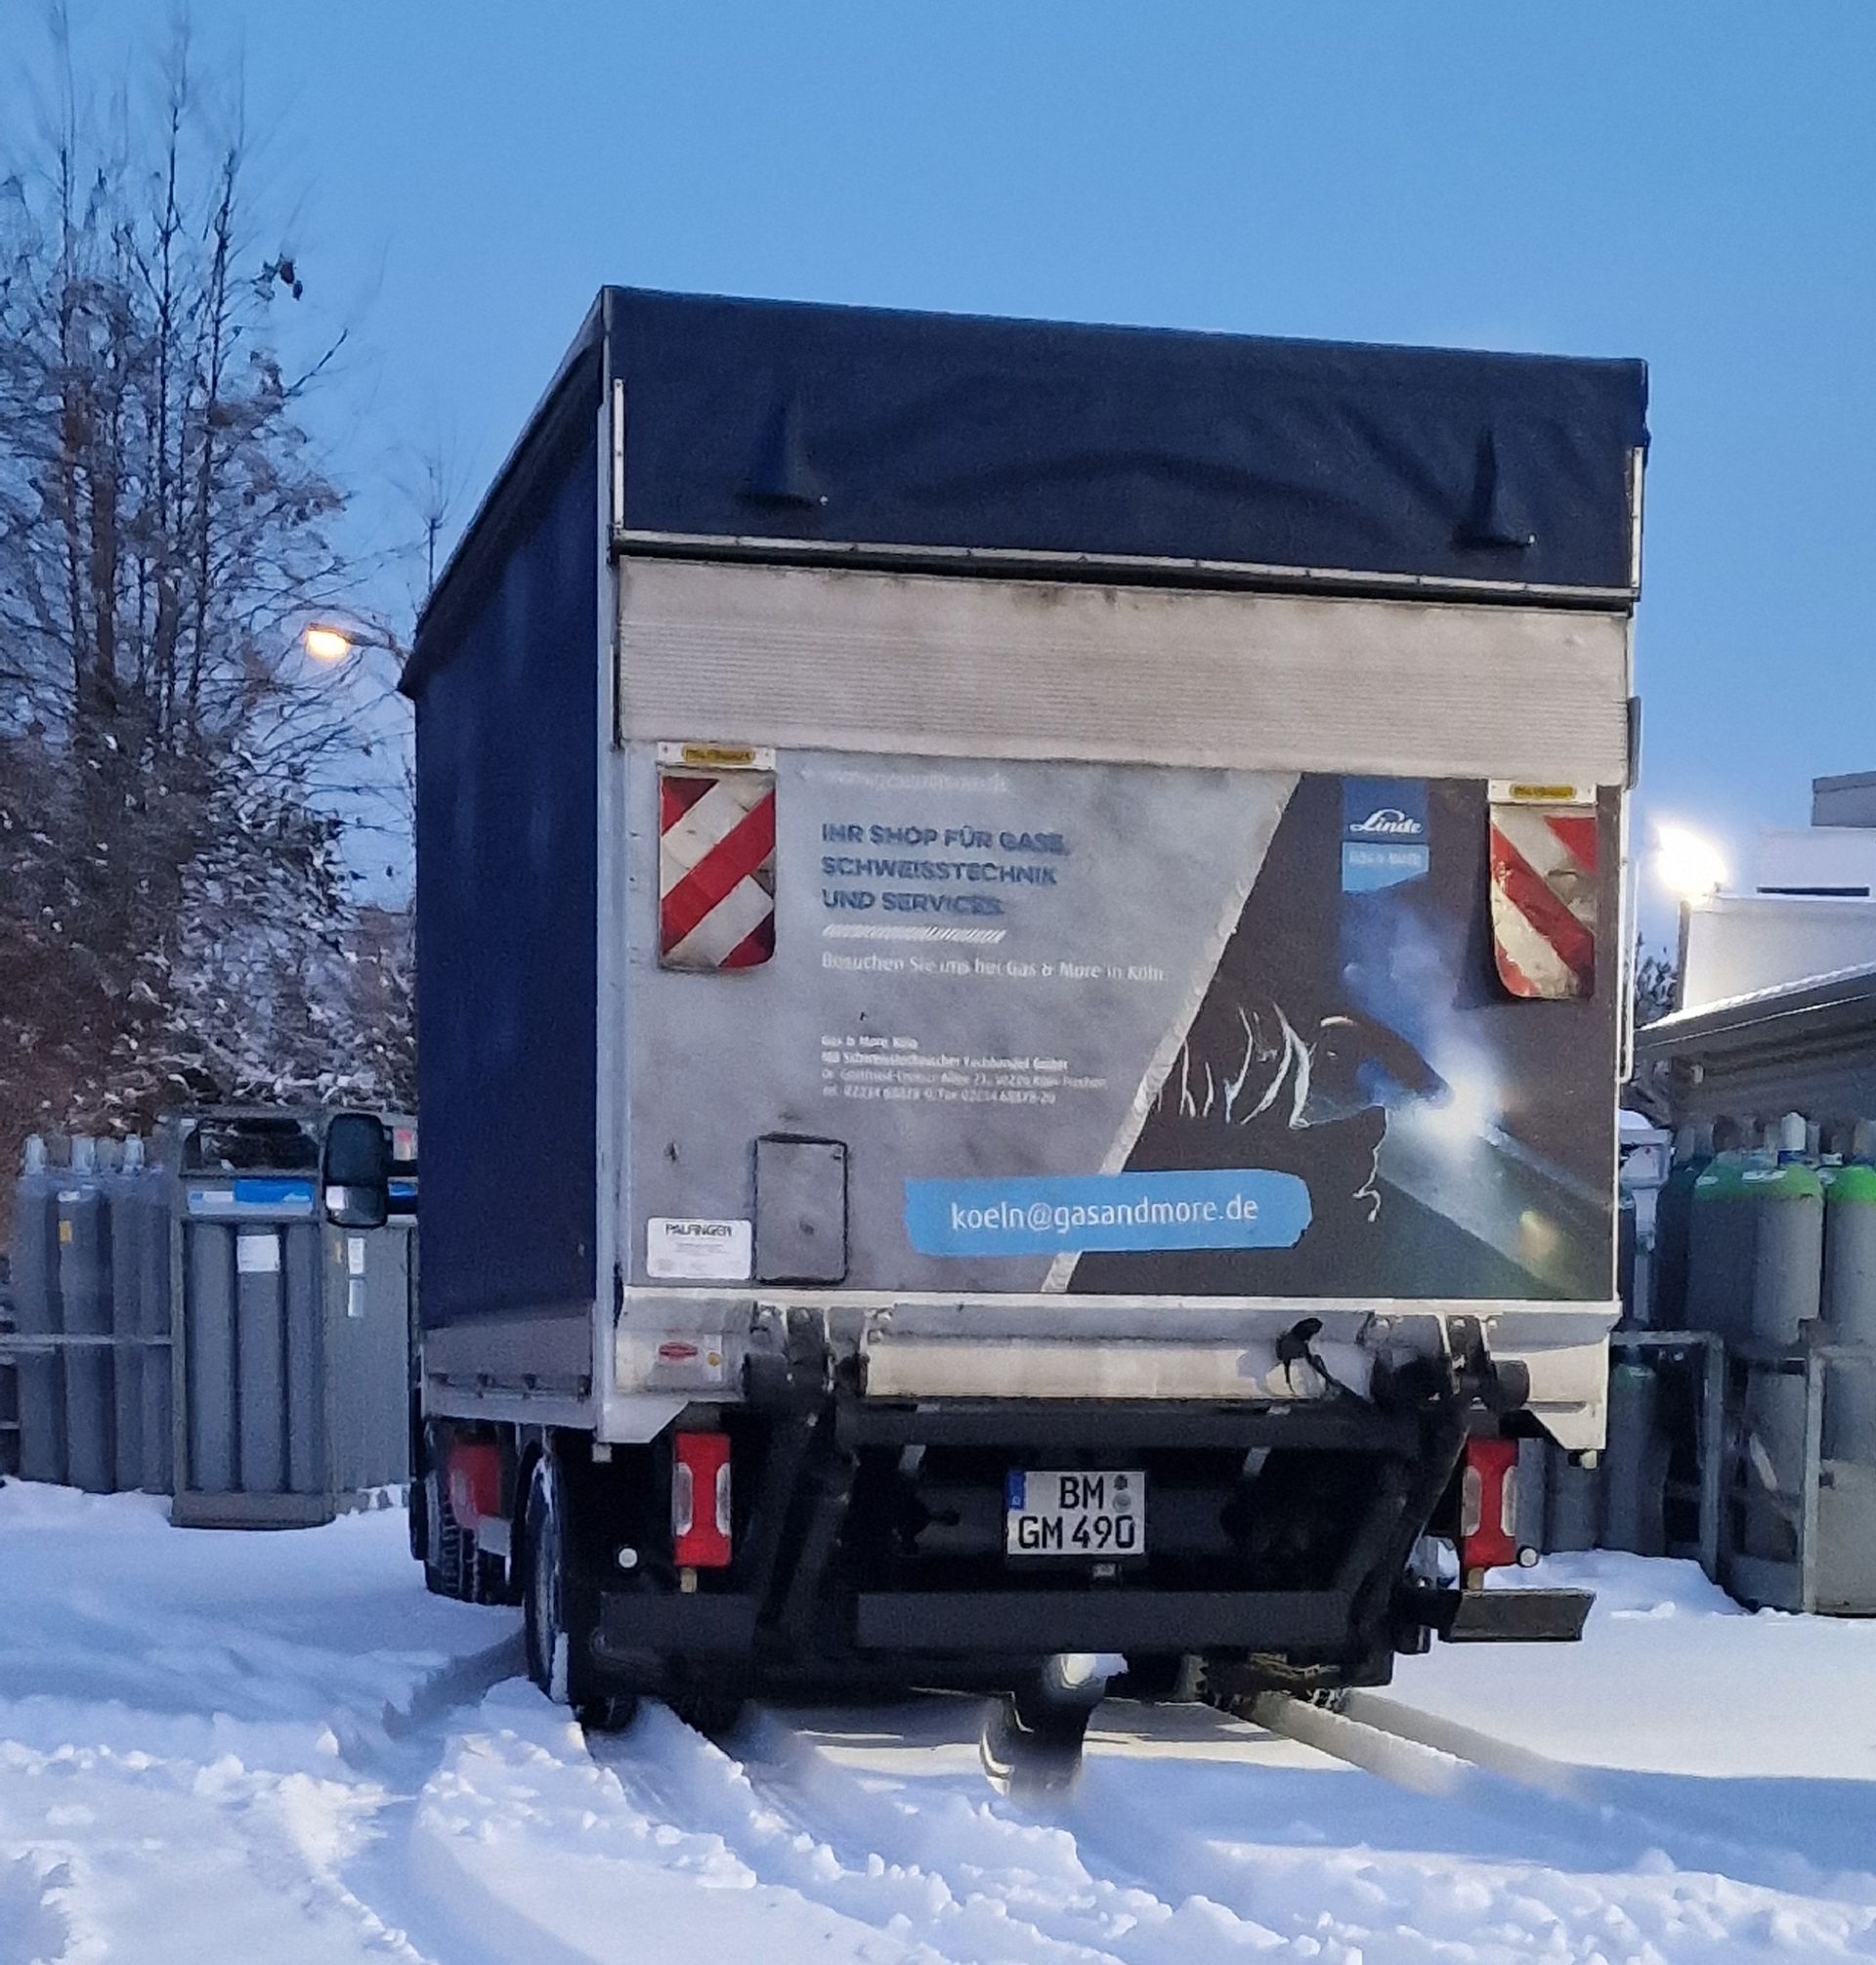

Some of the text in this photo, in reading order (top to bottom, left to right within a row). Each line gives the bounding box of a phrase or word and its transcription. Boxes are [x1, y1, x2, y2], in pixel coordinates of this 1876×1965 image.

[1350, 808, 1424, 833] Linde
[822, 823, 863, 843] IHR
[869, 825, 937, 846] SHOP
[944, 825, 992, 848] FÜR
[822, 856, 1056, 885] SCHWEISSTECHNIK
[822, 888, 875, 910] UND
[951, 1193, 1259, 1235] koeln@gasandmore.de
[1059, 1475, 1104, 1510] BM
[1018, 1515, 1135, 1549] GM 490
